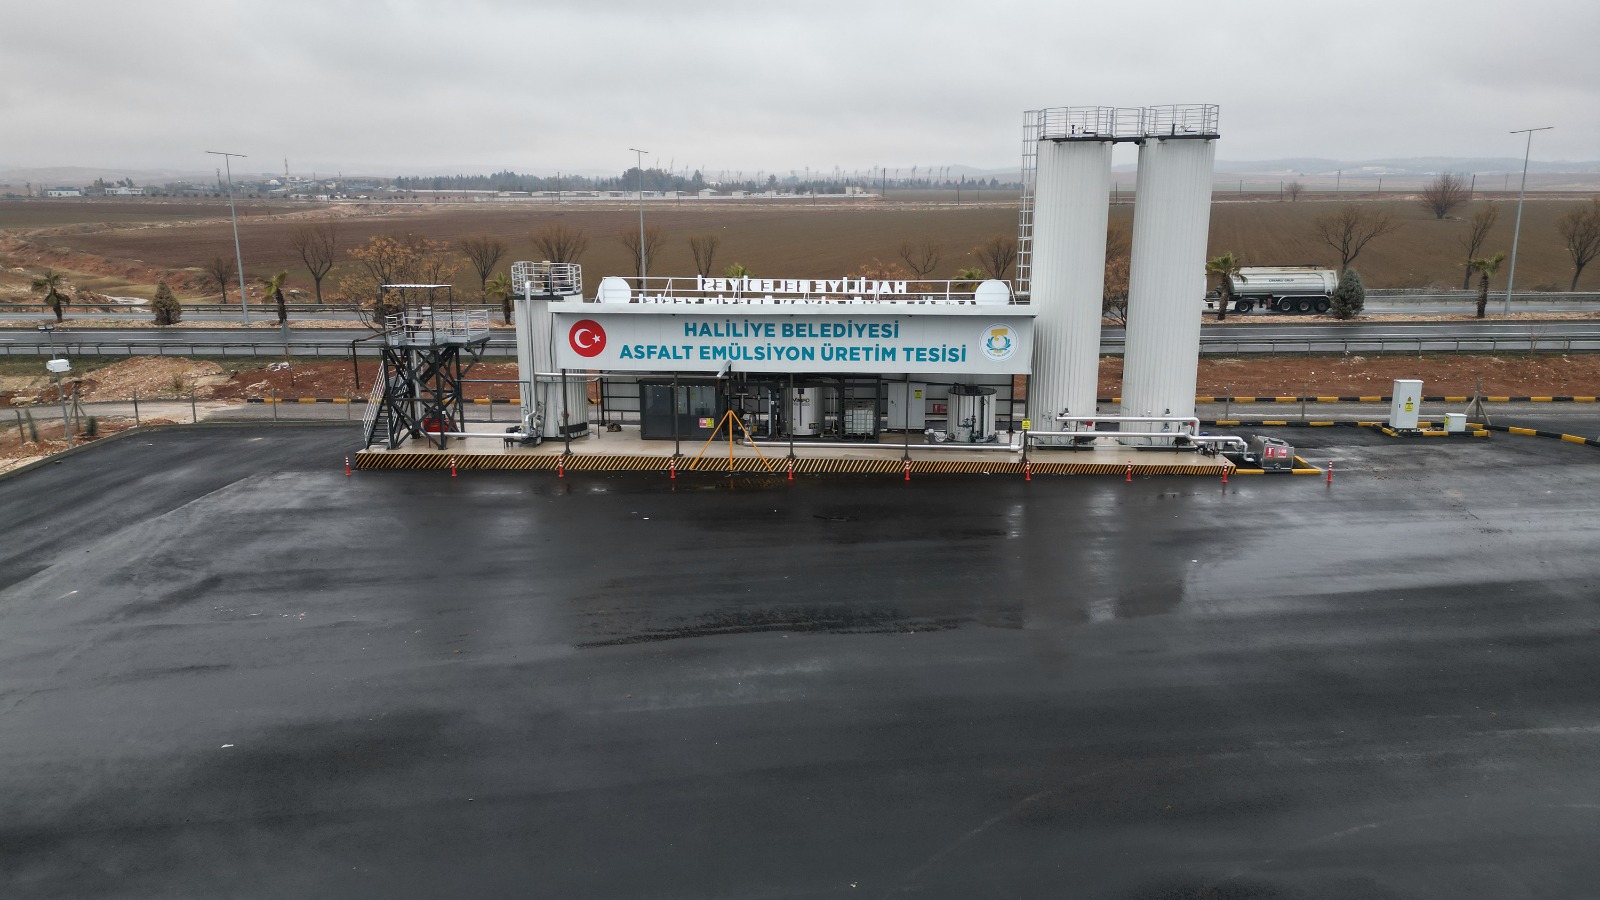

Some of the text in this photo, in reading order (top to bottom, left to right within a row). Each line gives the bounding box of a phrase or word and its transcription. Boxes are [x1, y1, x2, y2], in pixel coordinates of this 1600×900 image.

[684, 319, 899, 338] HALİLİYE BELEDİYESİ
[619, 344, 694, 360] ASFALT
[699, 342, 815, 361] EMÜLSİYON
[820, 343, 897, 361] ÜRETİM
[902, 344, 967, 362] TESİSİ
